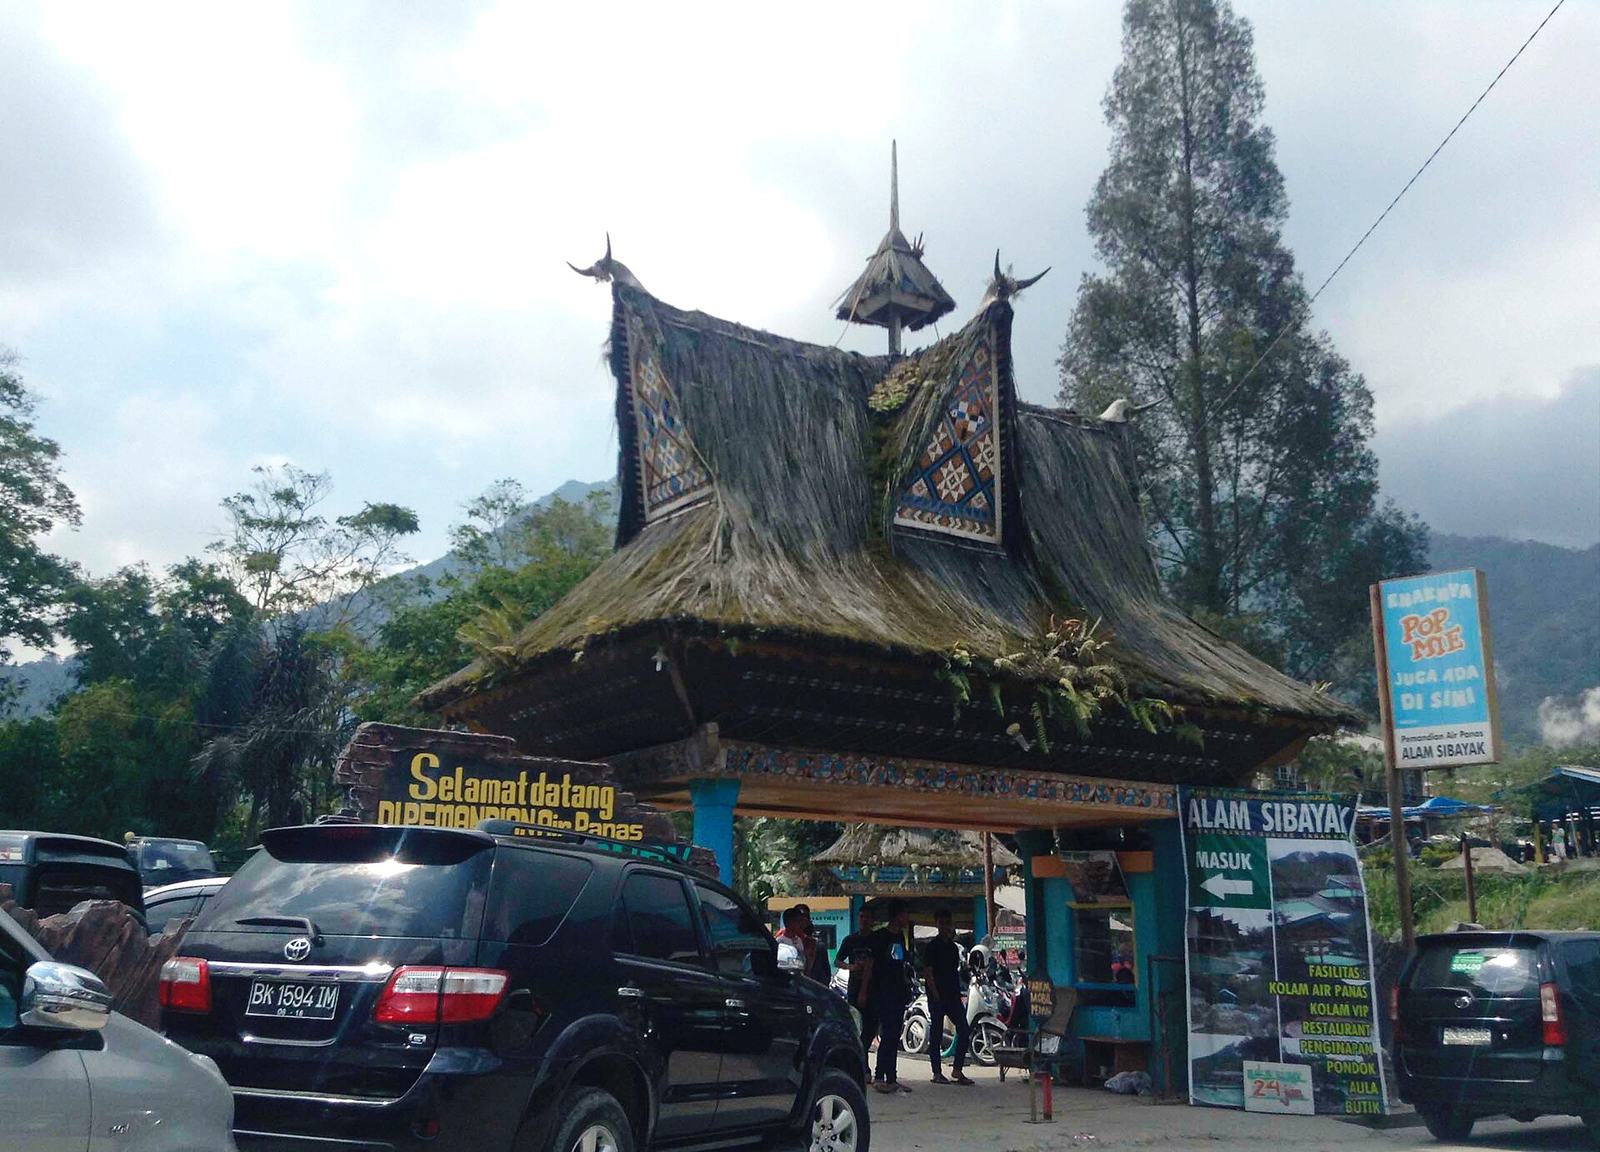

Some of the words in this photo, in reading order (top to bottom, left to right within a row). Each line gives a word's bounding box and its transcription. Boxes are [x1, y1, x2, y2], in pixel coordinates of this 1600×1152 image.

[1401, 609, 1448, 644] POP
[1410, 628, 1464, 661] MIE
[1395, 669, 1437, 686] JUGA
[1443, 665, 1479, 683] ADA
[1400, 693, 1423, 710] DI
[1430, 687, 1475, 708] SINI
[1401, 733, 1444, 742] Pemandian
[1446, 731, 1458, 739] Air
[1459, 730, 1484, 738] Panas
[1402, 745, 1434, 760] ALAM
[1436, 742, 1485, 758] SIBAYAK
[409, 752, 527, 803] Selamat
[532, 772, 614, 819] datang
[1189, 799, 1250, 830] ALAM
[1261, 802, 1350, 834] SIBAYAK
[577, 812, 643, 841] Panas
[1196, 850, 1253, 870] MASUK
[1309, 965, 1360, 979] FASILITAS
[252, 983, 273, 1005] BK
[277, 985, 314, 1007] 1594
[315, 986, 337, 1009] IM
[1269, 982, 1309, 996] KOLAM
[1312, 983, 1331, 997] AIR
[1334, 984, 1368, 999] PANAS
[1310, 1002, 1350, 1016] KOLAM
[1352, 1005, 1369, 1017] VIP
[1302, 1021, 1370, 1037] RESTAURANT
[1299, 1040, 1374, 1056] PENGINAPAN
[1326, 1061, 1376, 1076] PONDOK
[1254, 1079, 1280, 1097] 24
[1350, 1081, 1378, 1095] AULA
[1345, 1100, 1380, 1114] BUTIK
